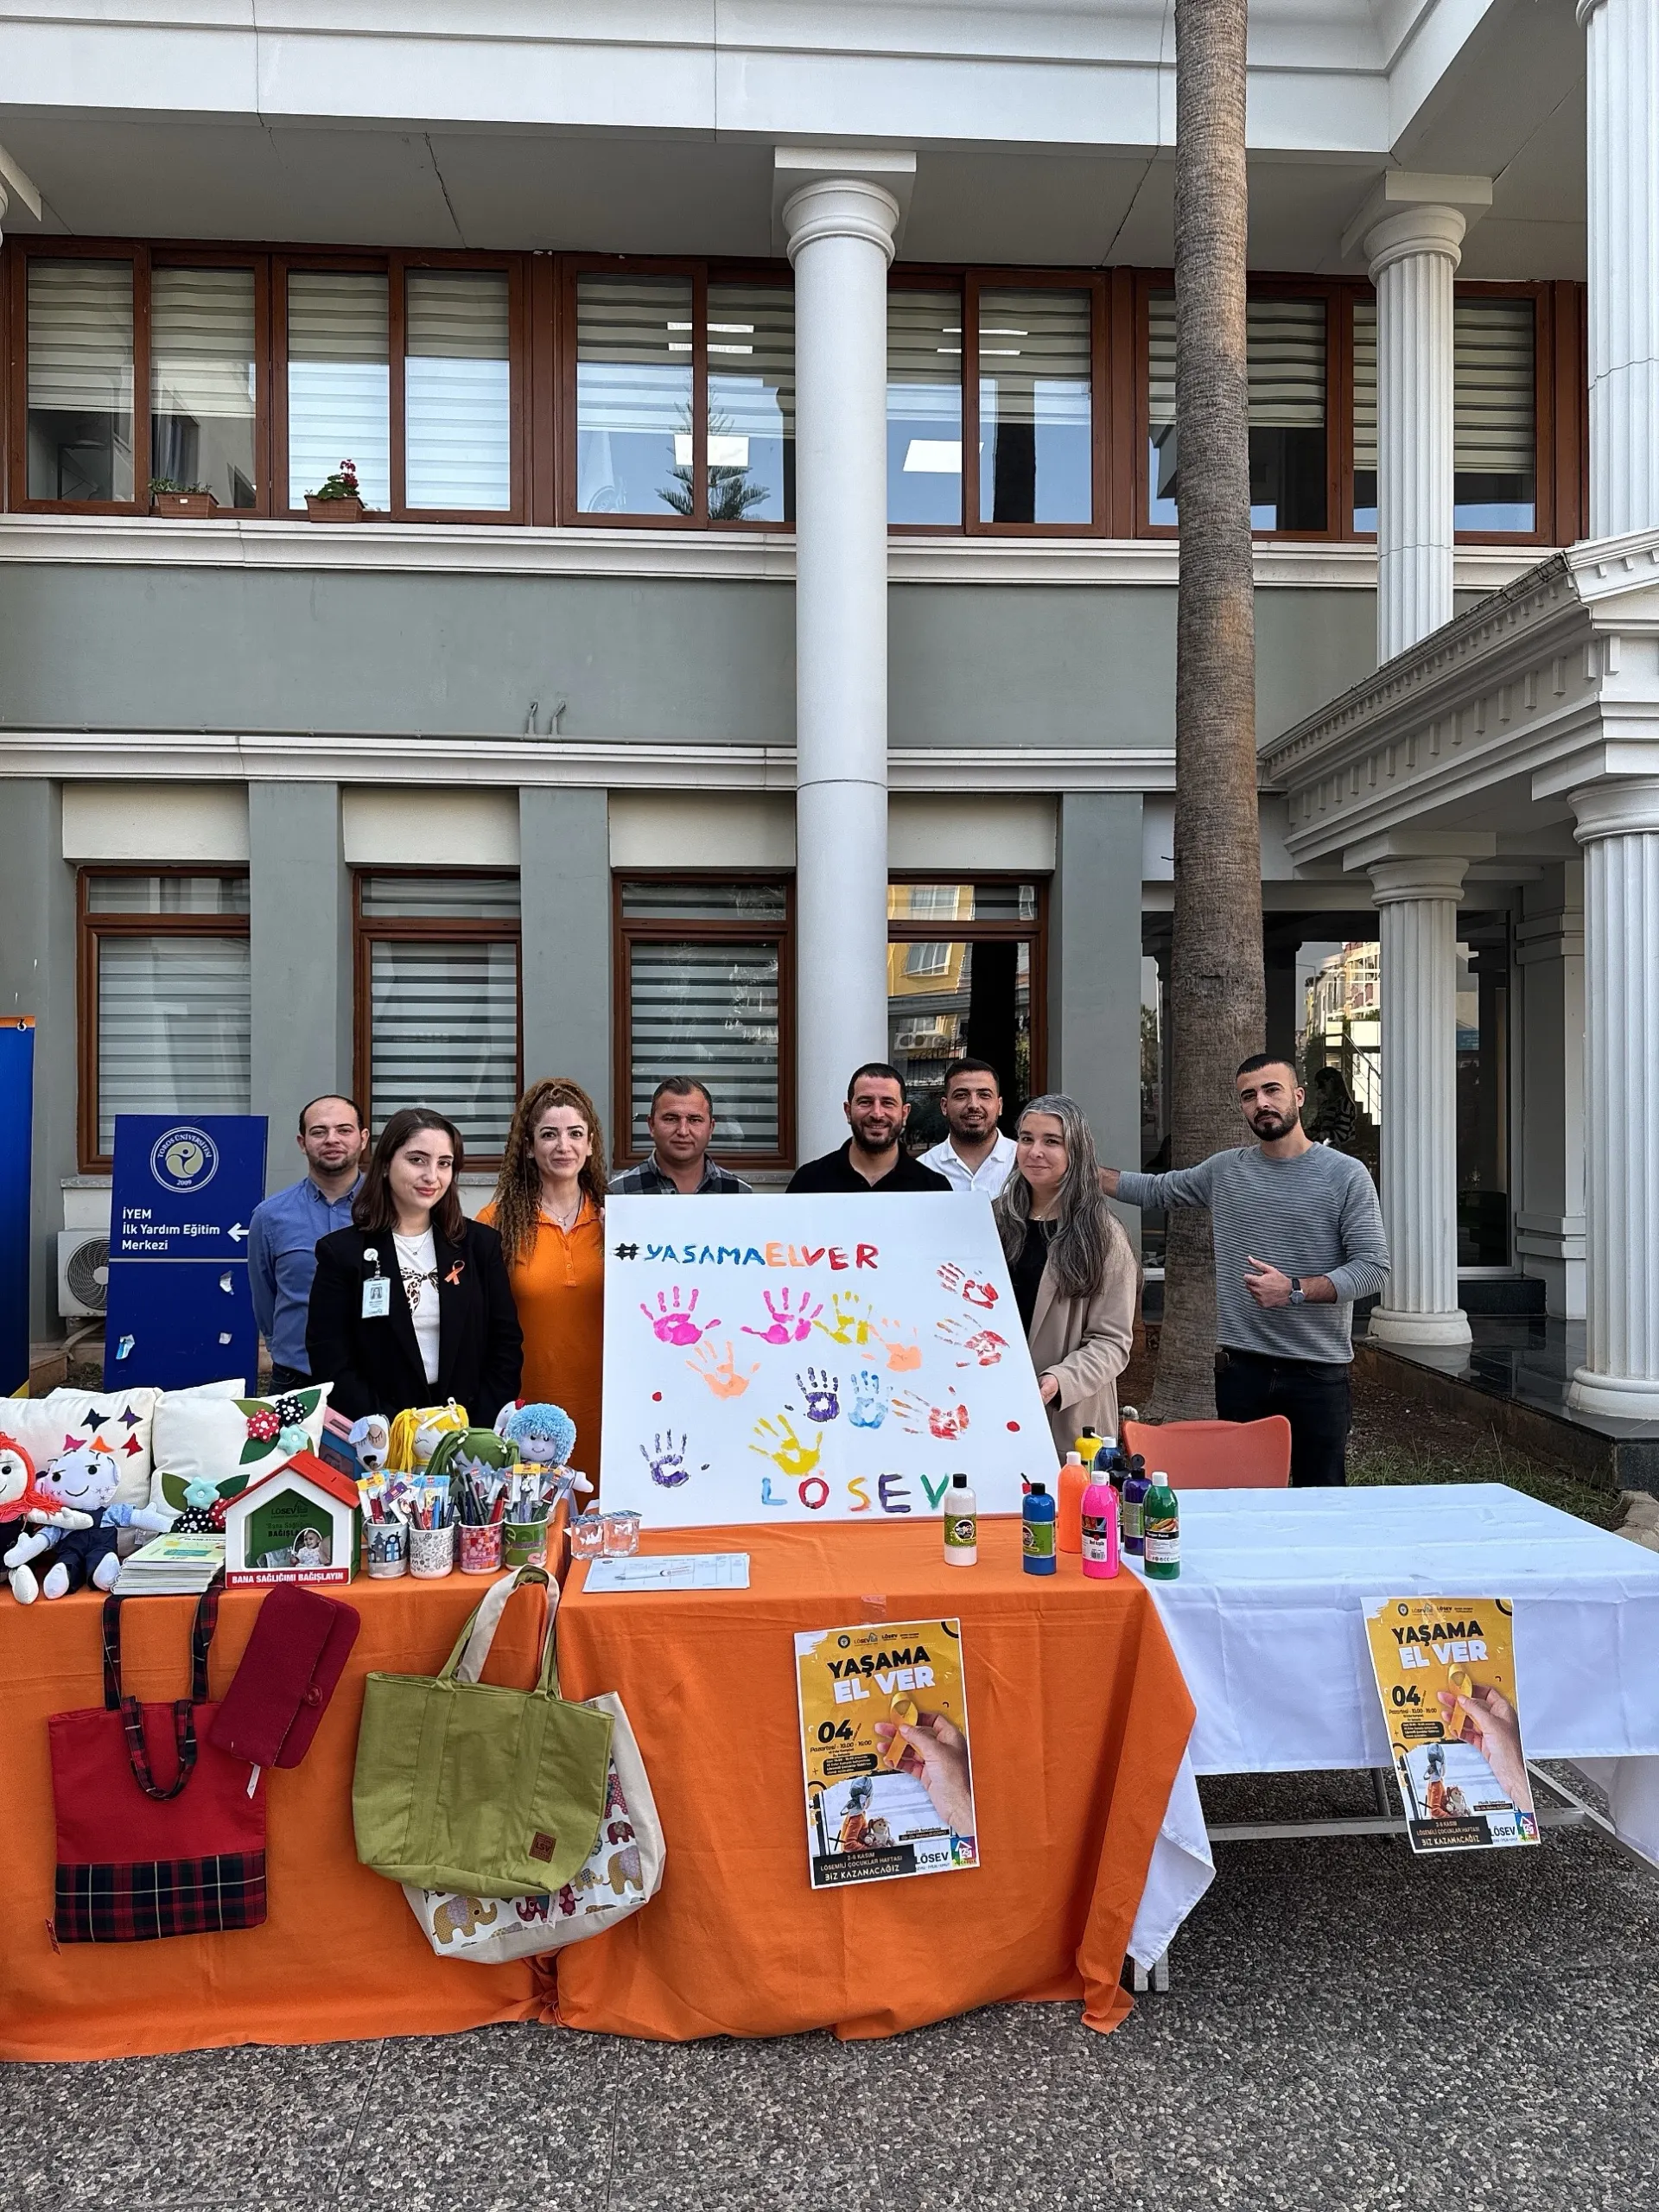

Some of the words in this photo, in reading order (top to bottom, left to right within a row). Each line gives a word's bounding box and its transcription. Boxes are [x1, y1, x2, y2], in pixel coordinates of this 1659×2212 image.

[157, 1136, 175, 1159] TOROS
[122, 1206, 152, 1219] İYEM
[122, 1222, 137, 1235] İlk
[140, 1224, 180, 1235] Yardım
[182, 1223, 220, 1237] Eğitim
[121, 1239, 168, 1250] Merkezi
[232, 1575, 254, 1584] BANA
[256, 1573, 296, 1583] SAĞLIĞIMI
[298, 1572, 344, 1583] BAĞIŞLAYIN
[1391, 1620, 1484, 1646] YAŞAMA
[827, 1645, 931, 1678] YAŞAMA
[1398, 1645, 1430, 1669] EL
[1431, 1639, 1489, 1665] VER
[833, 1677, 870, 1704] EL
[874, 1665, 936, 1694] VER
[1392, 1685, 1421, 1707] 04
[817, 1719, 853, 1744] 04
[1433, 1834, 1480, 1845] KAZANACAĞIZ
[848, 1859, 878, 1868] ÇOCUKLAR
[915, 1852, 949, 1865] LÖSEV
[824, 1872, 839, 1881] BİZ
[841, 1864, 900, 1879] KAZANACAĞIZ
